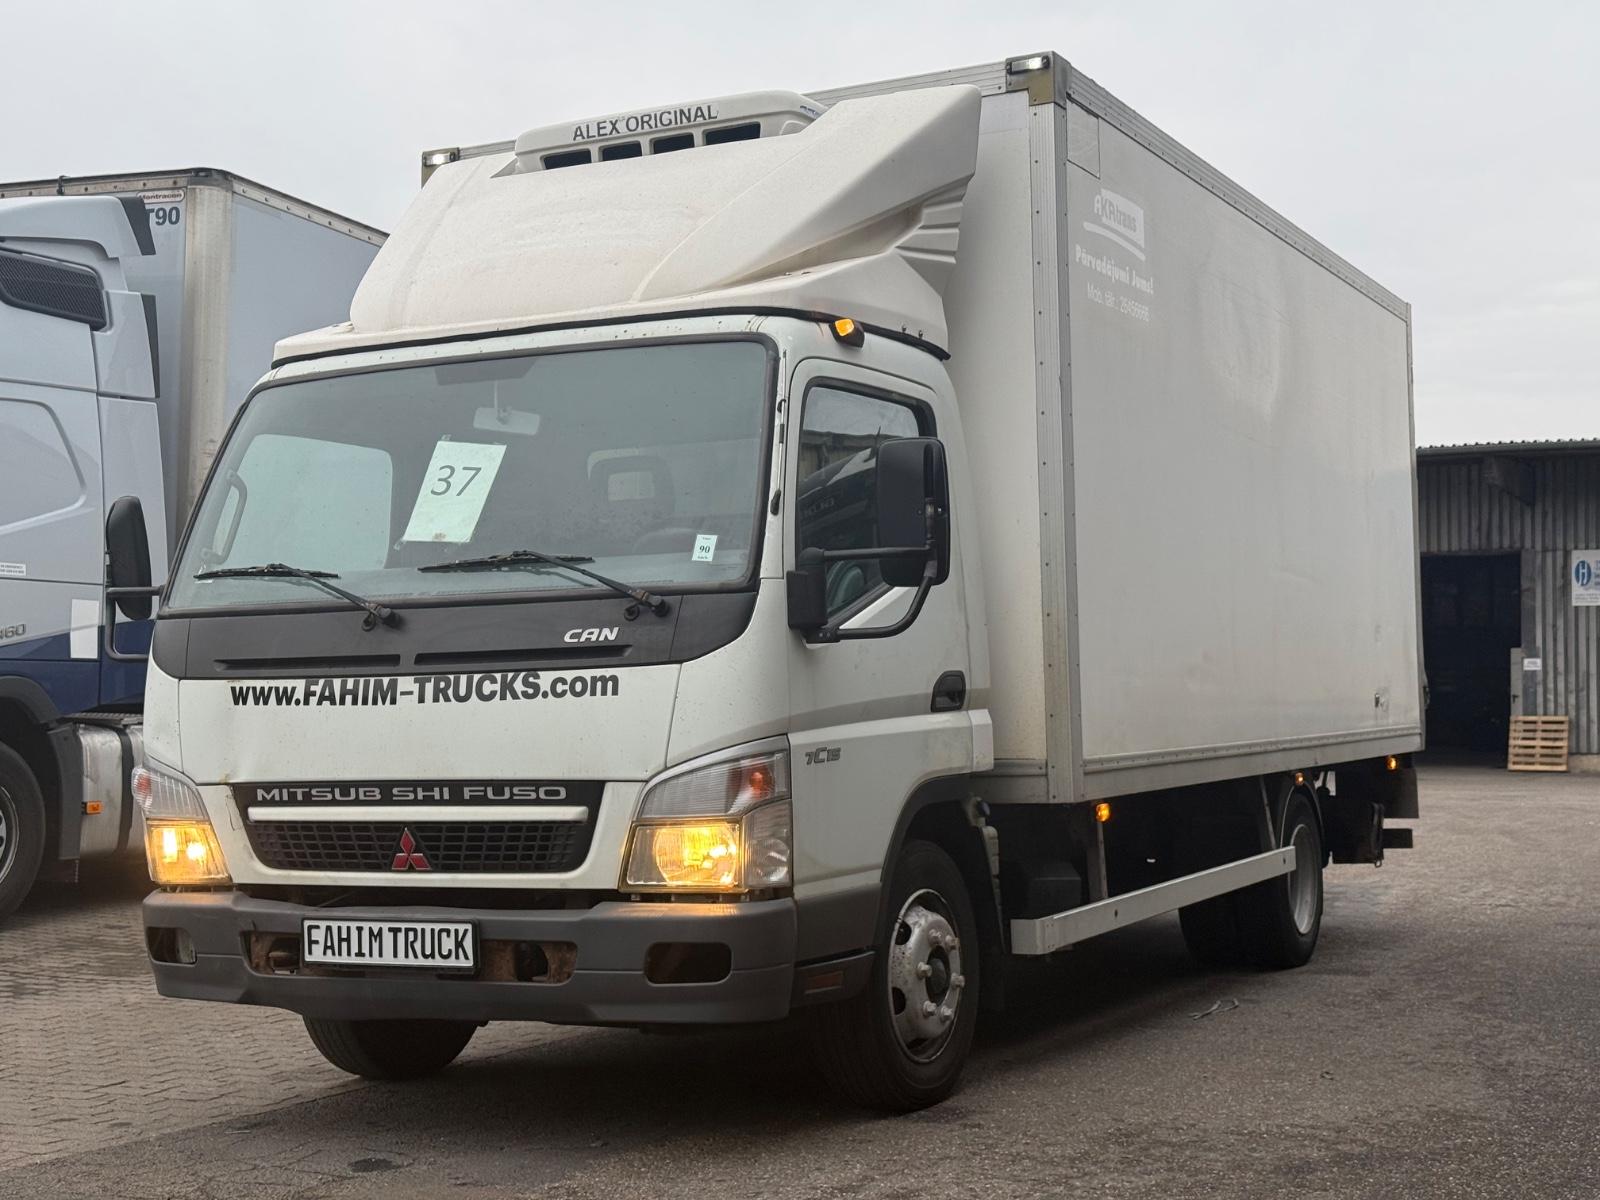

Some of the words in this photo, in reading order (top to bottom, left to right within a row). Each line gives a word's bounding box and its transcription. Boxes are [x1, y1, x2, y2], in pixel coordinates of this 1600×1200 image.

[573, 119, 619, 142] ALEX
[625, 105, 718, 132] ORIGINAL
[430, 465, 482, 497] 37
[699, 545, 711, 554] 90
[564, 626, 620, 643] CAN
[230, 671, 620, 706] www.FAHIM-TRUCKS.com
[463, 786, 567, 800] FUSO
